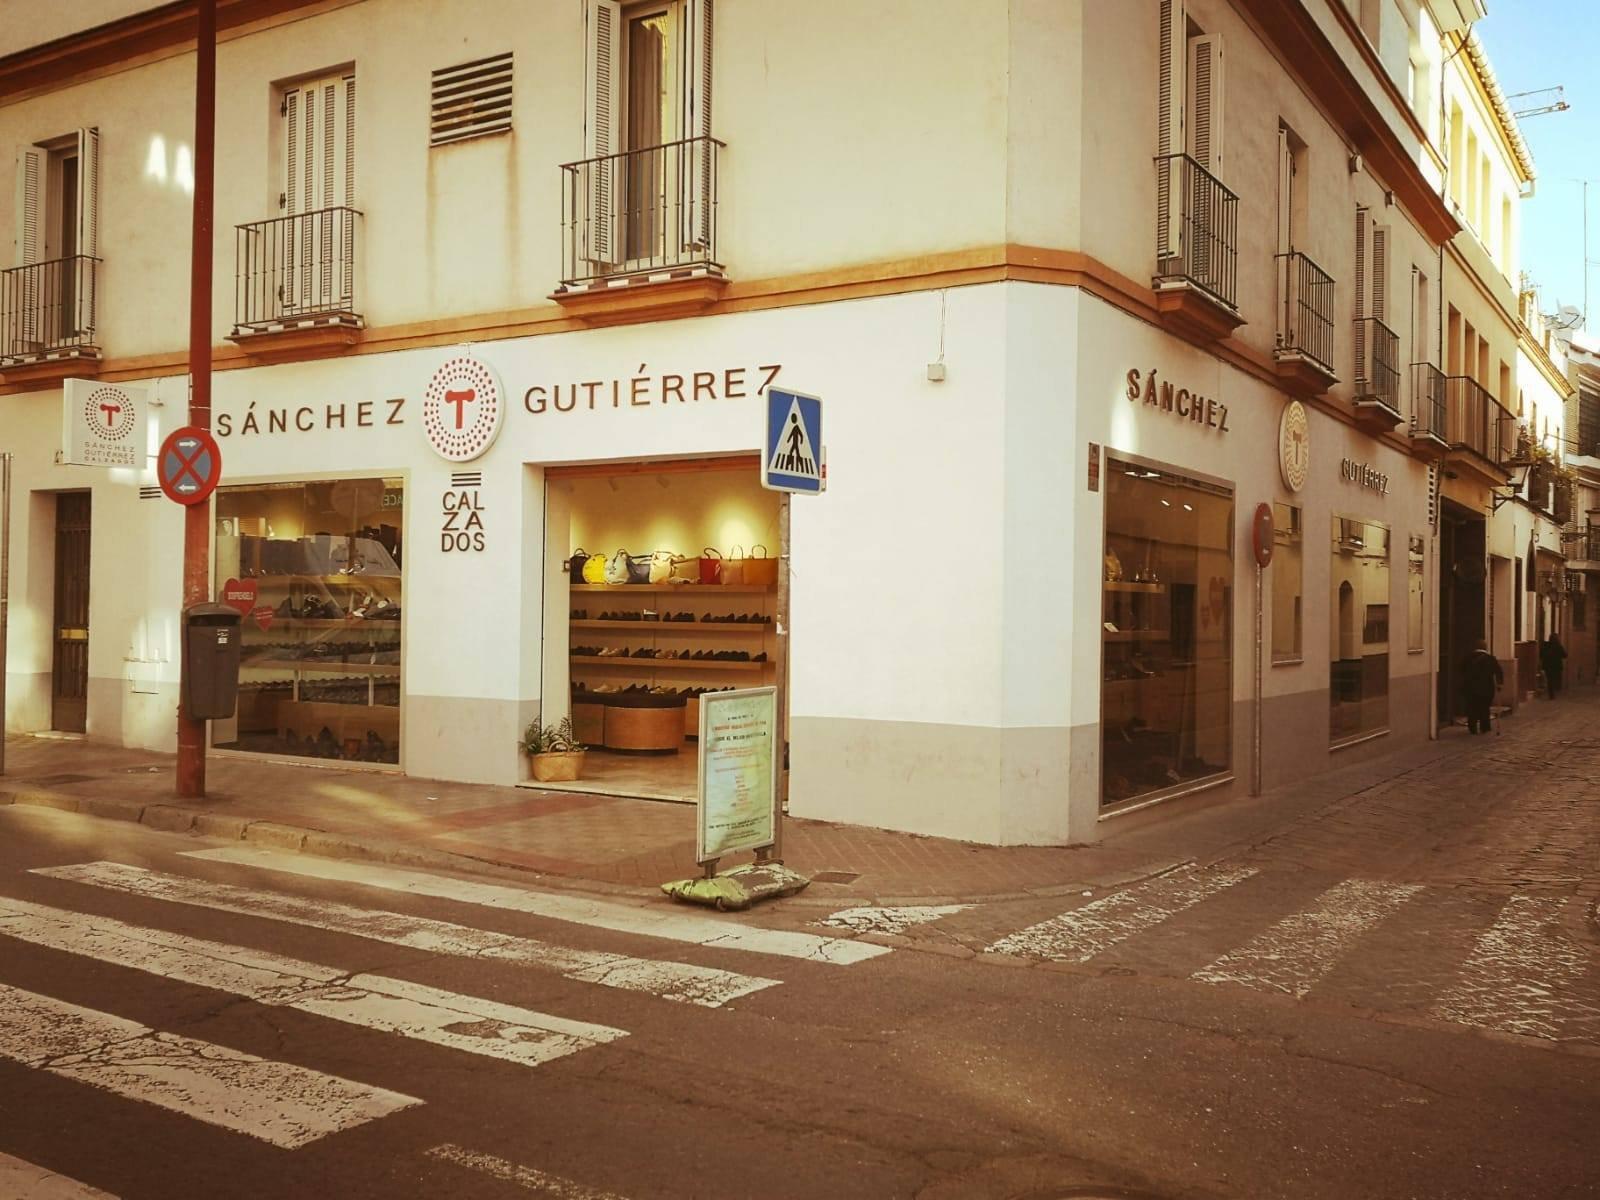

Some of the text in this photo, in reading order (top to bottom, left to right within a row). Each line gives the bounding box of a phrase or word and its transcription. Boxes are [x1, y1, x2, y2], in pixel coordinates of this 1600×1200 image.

[217, 363, 782, 437] SÁNCHEZ GUTIÉRREZ
[1126, 368, 1390, 495] SÁNCHEZ GUTIÉRREZ
[442, 490, 485, 511] CAL
[442, 510, 484, 531] ZA
[441, 532, 485, 552] DOS
